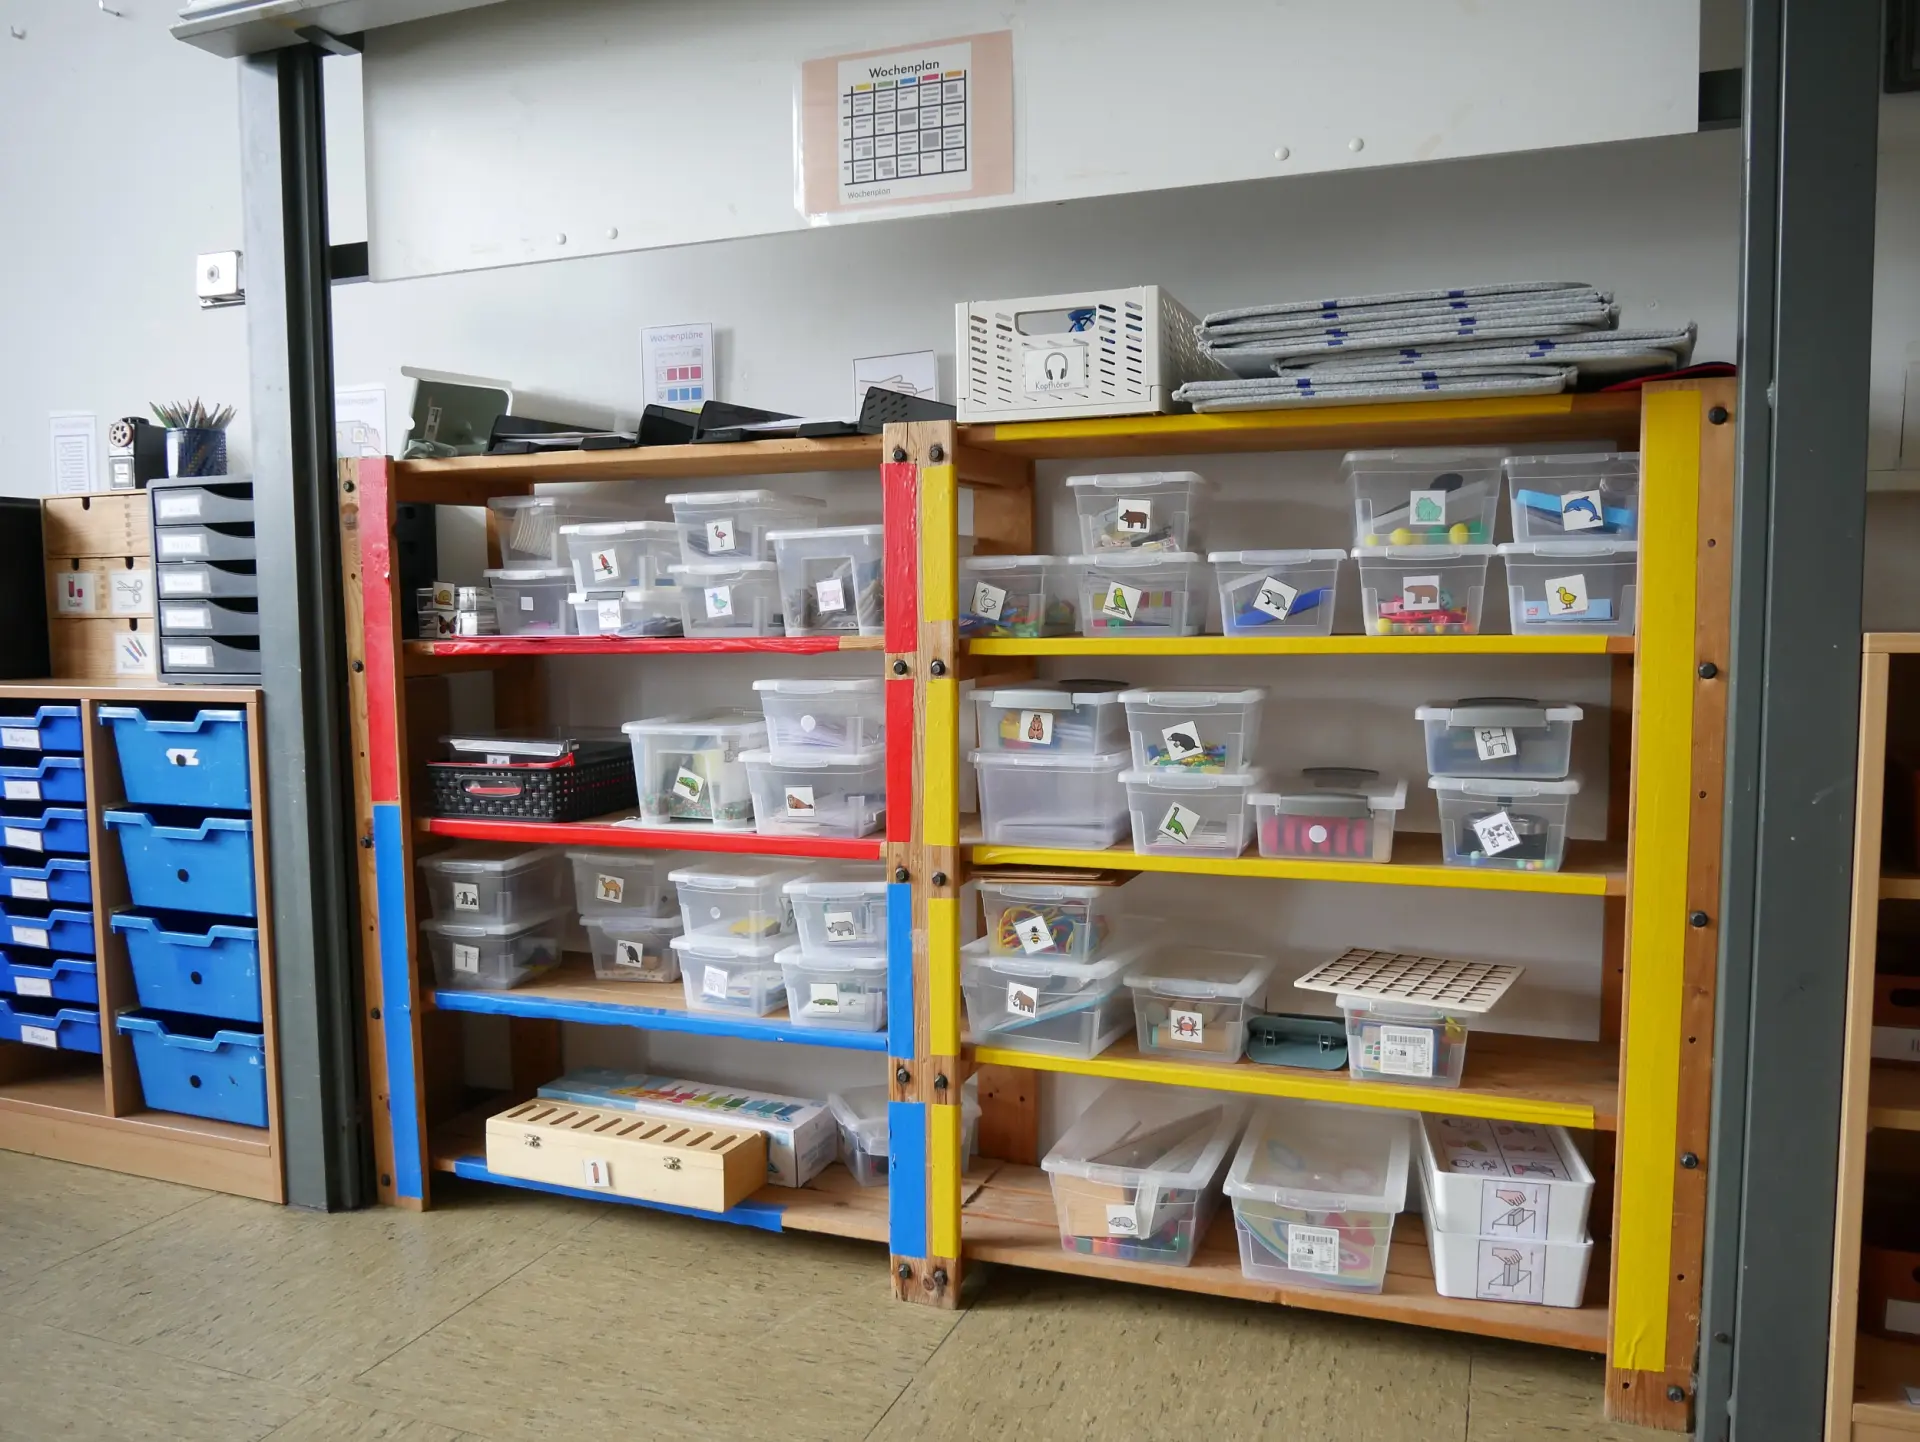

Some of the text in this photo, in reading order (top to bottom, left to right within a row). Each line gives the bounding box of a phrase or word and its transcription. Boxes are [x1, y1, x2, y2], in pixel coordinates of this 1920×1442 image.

[869, 60, 940, 78] Wochenplan
[847, 187, 891, 199] Wochenplan
[1035, 381, 1071, 391] Kopfhörer
